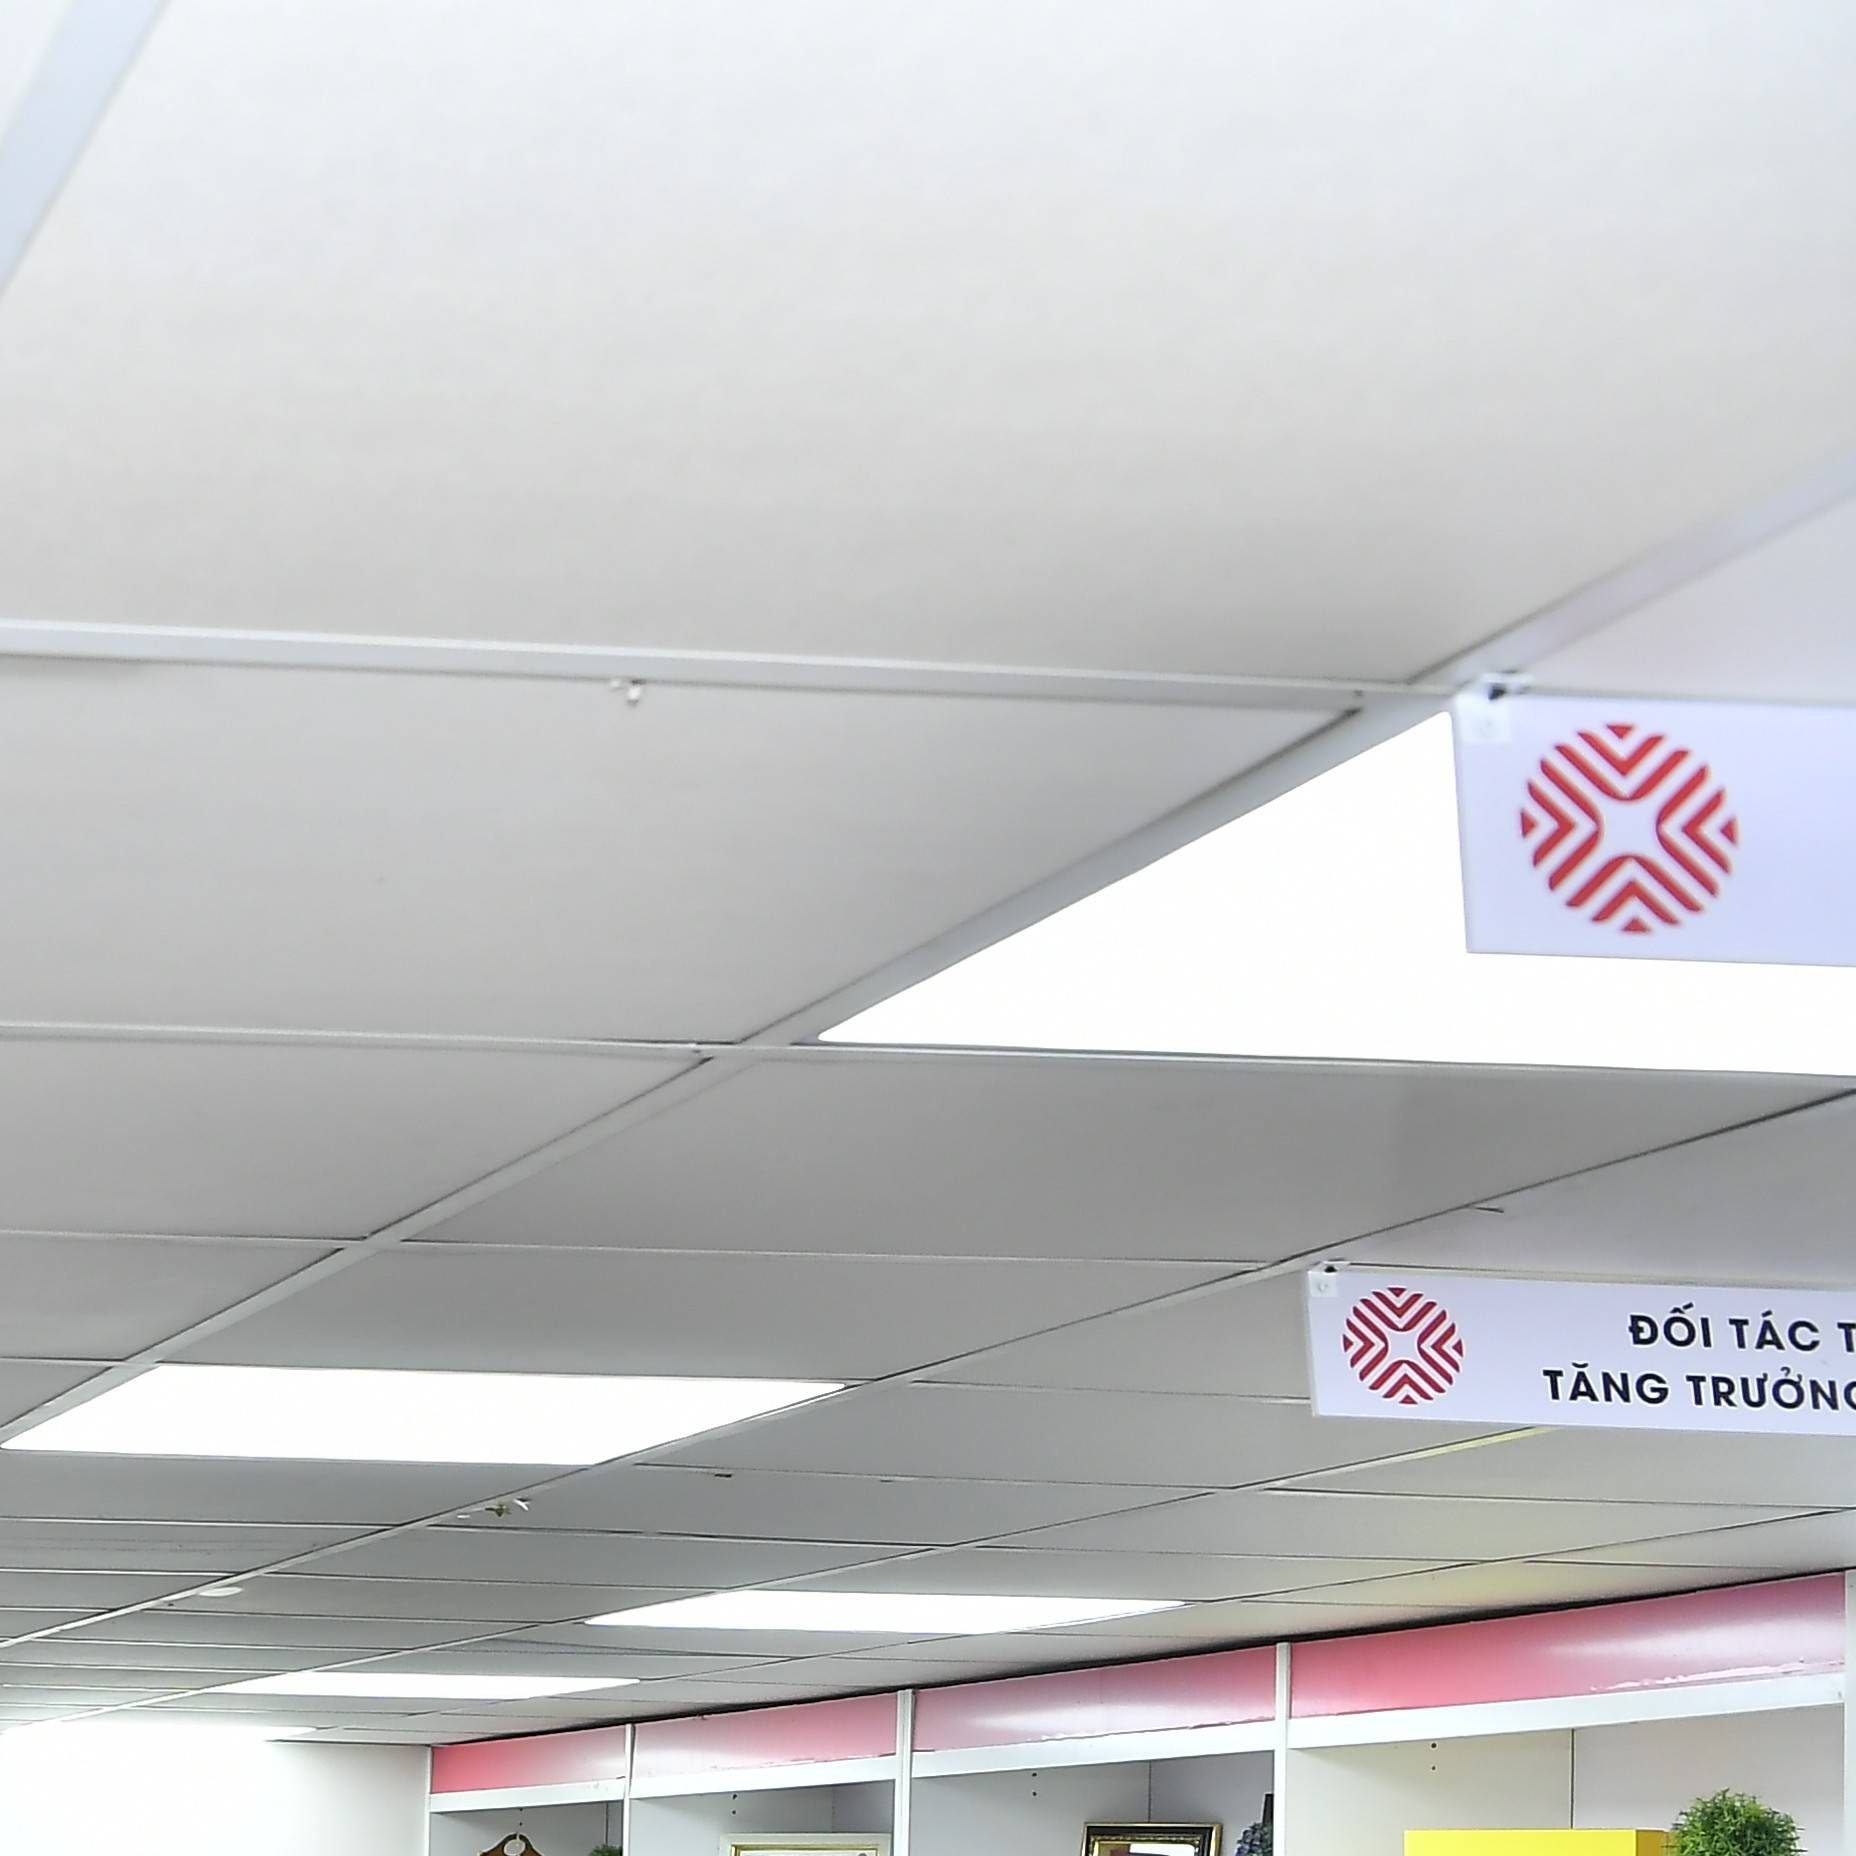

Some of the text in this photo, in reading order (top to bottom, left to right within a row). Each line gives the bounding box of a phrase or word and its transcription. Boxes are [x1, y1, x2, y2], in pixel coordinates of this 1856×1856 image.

[1628, 1303, 1712, 1348] ĐỐI
[1728, 1311, 1820, 1352] TÁC
[1542, 1363, 1670, 1403] TĂNG
